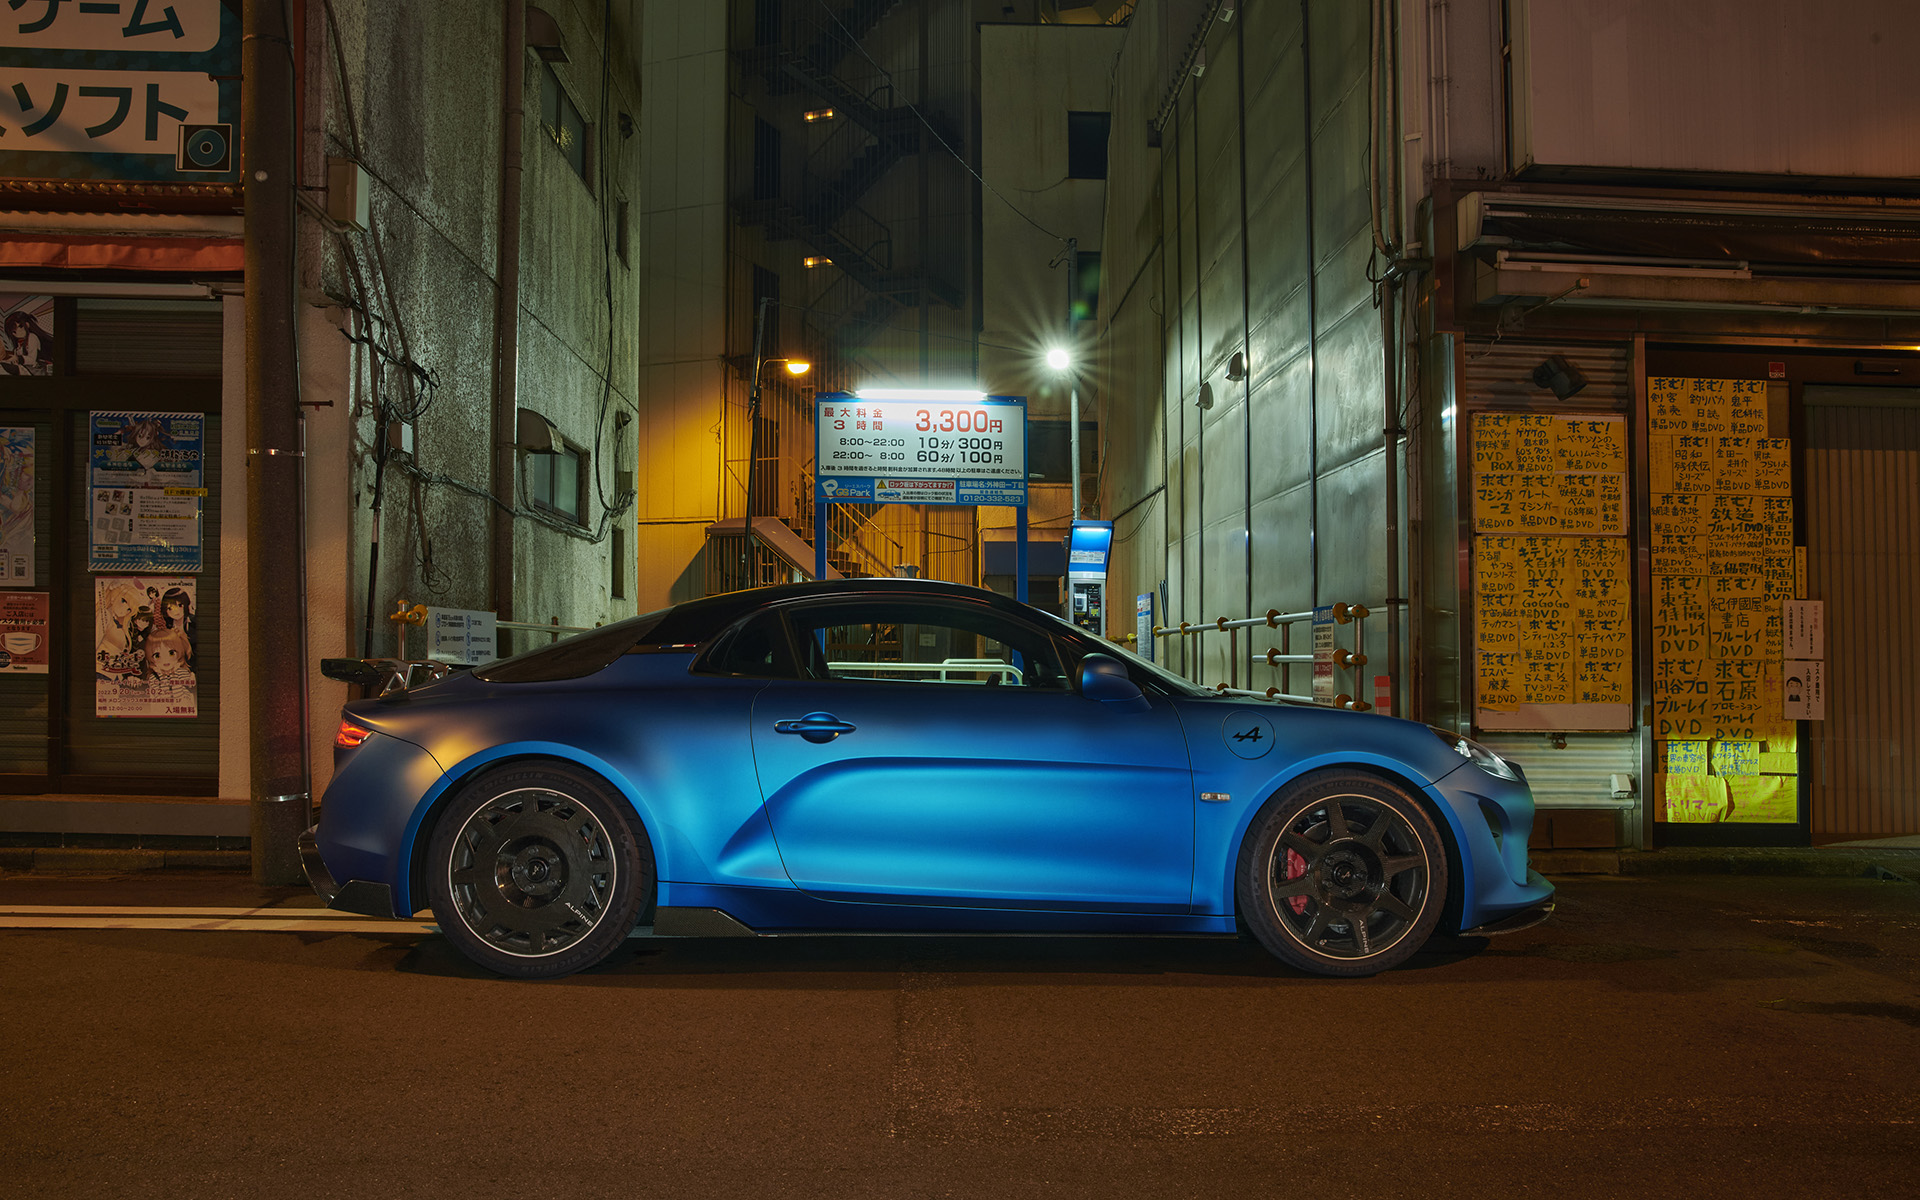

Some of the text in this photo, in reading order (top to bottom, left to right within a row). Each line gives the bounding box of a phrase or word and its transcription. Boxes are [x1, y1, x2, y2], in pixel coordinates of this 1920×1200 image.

[824, 407, 883, 418] 最大料金
[915, 409, 1003, 433] 3,300円
[1476, 429, 1511, 439] アパッチ
[1477, 452, 1503, 462] DVD
[1715, 448, 1744, 459] 金田一
[1753, 450, 1771, 462] 男は
[1491, 461, 1514, 471] BOX
[1760, 460, 1790, 469] つらいよ
[1679, 472, 1705, 481] シリーズ
[1719, 468, 1747, 478] シリーズ
[1755, 468, 1784, 478] シリーズ
[963, 495, 1021, 503] 0120-332-523
[1764, 537, 1791, 546] DVD
[1519, 547, 1568, 558] キテレツ
[1491, 561, 1514, 570] やつら
[1577, 559, 1617, 568] Blu-ray
[1528, 569, 1559, 578] DVD
[1582, 569, 1615, 578] DVD
[1523, 589, 1563, 599] マッハ
[1660, 591, 1697, 607] 東宝
[1481, 619, 1517, 629] テッカマン
[1721, 612, 1750, 629] 書店
[1661, 639, 1699, 654] DVD
[1720, 645, 1753, 657] DVD
[1480, 668, 1514, 678] エスパー
[1579, 673, 1609, 683] めぞん
[1716, 680, 1757, 702] 石原
[165, 706, 195, 714] 入場無料
[1656, 695, 1708, 715] ブルーレイ
[1711, 702, 1762, 711] プロモーション
[1712, 712, 1755, 724] ブルーレイ
[1660, 719, 1702, 735] DVD
[1716, 728, 1754, 740] DVD
[565, 902, 596, 927] ALPINE
[1359, 919, 1369, 954] ALPINE
